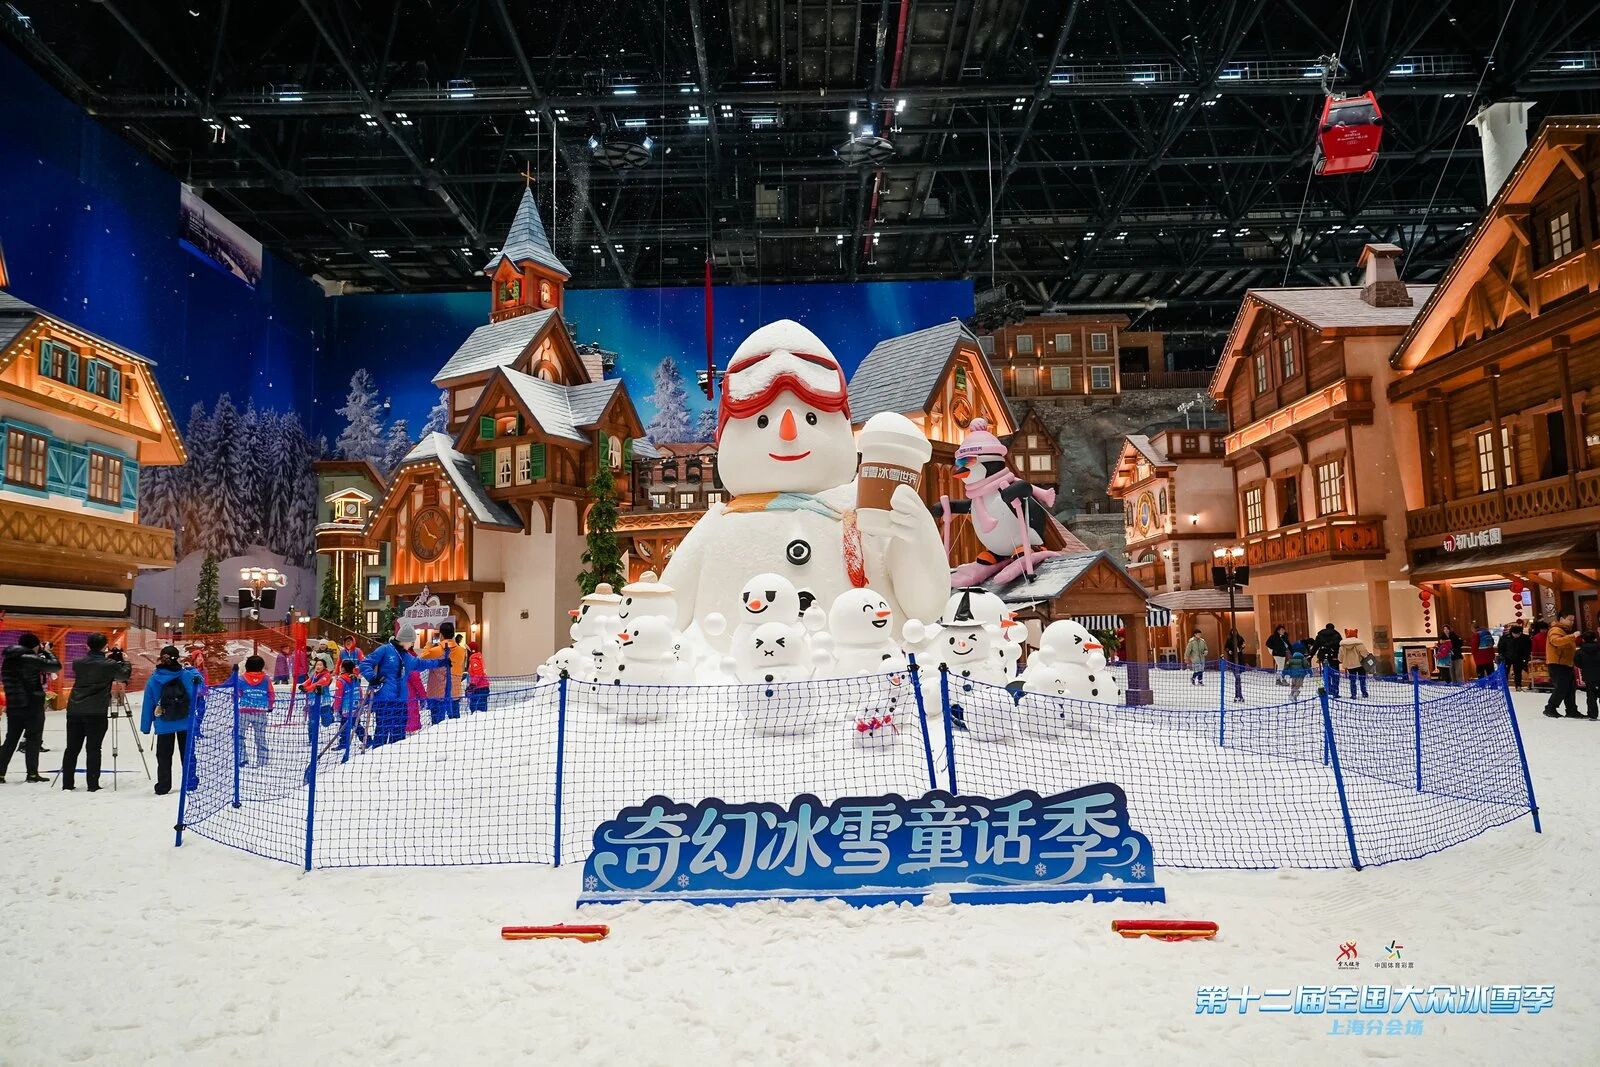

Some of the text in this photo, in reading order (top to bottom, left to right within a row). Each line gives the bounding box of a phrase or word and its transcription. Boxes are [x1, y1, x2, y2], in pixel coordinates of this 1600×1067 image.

[594, 793, 1140, 891] 奇幻冰雪童话季
